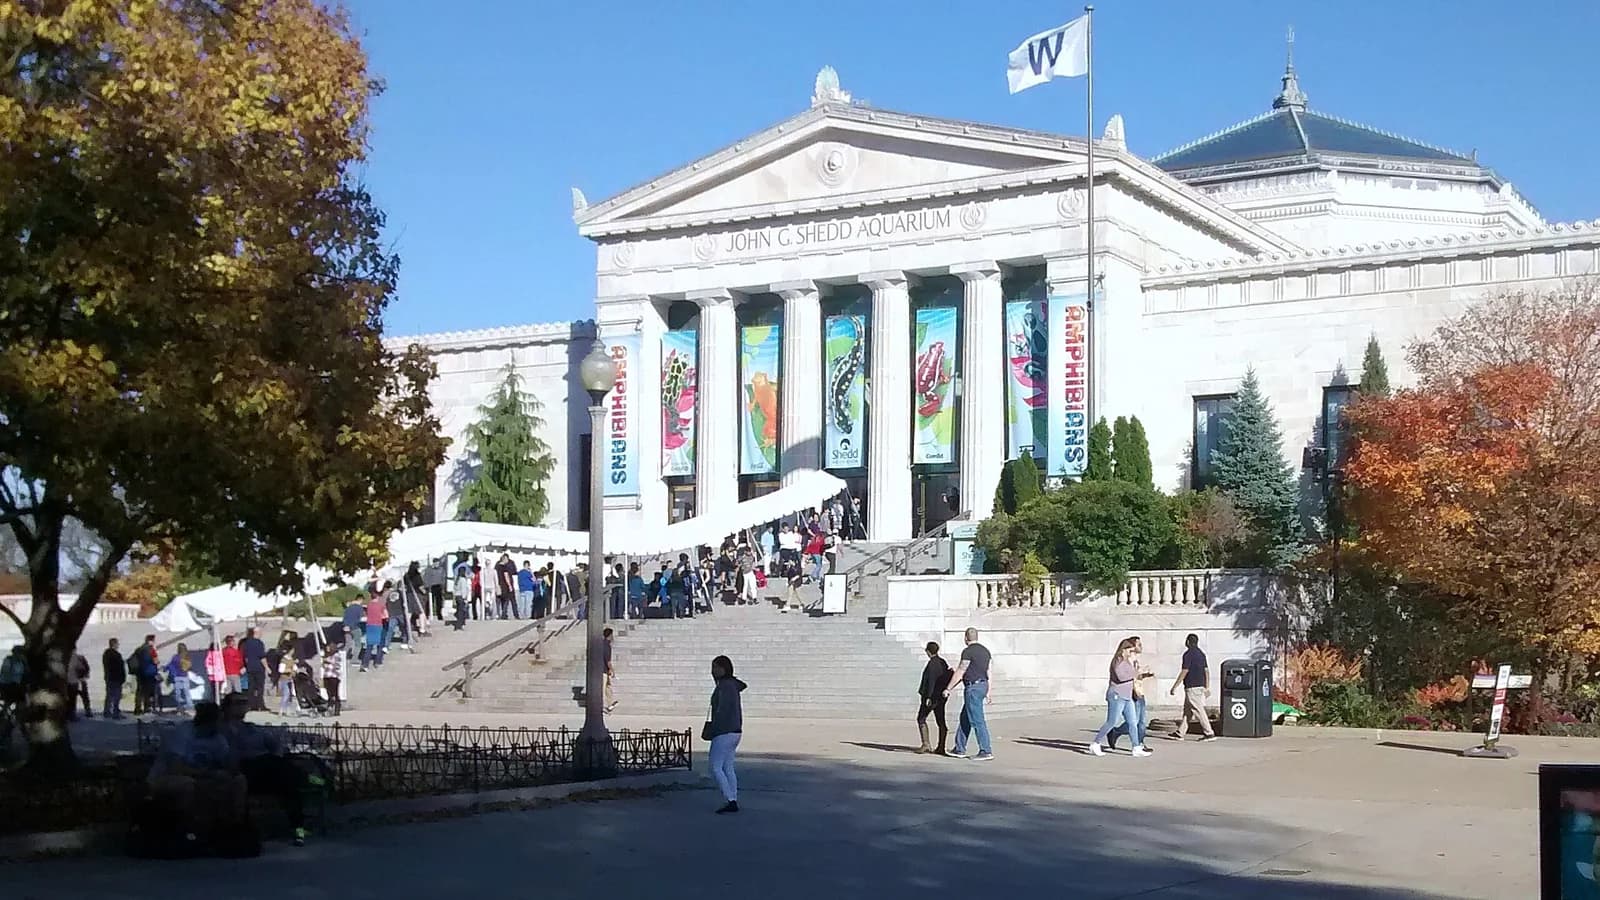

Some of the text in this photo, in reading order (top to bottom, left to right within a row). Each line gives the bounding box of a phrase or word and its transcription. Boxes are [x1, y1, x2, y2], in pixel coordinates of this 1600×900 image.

[1028, 31, 1065, 76] W
[726, 231, 771, 251] JOHN
[797, 221, 852, 245] SHEDD
[857, 209, 950, 238] AQUARIUM
[1065, 305, 1085, 463] AMPHIBIANS
[611, 345, 627, 484] AMPHIBIANS
[832, 448, 859, 459] Shedd
